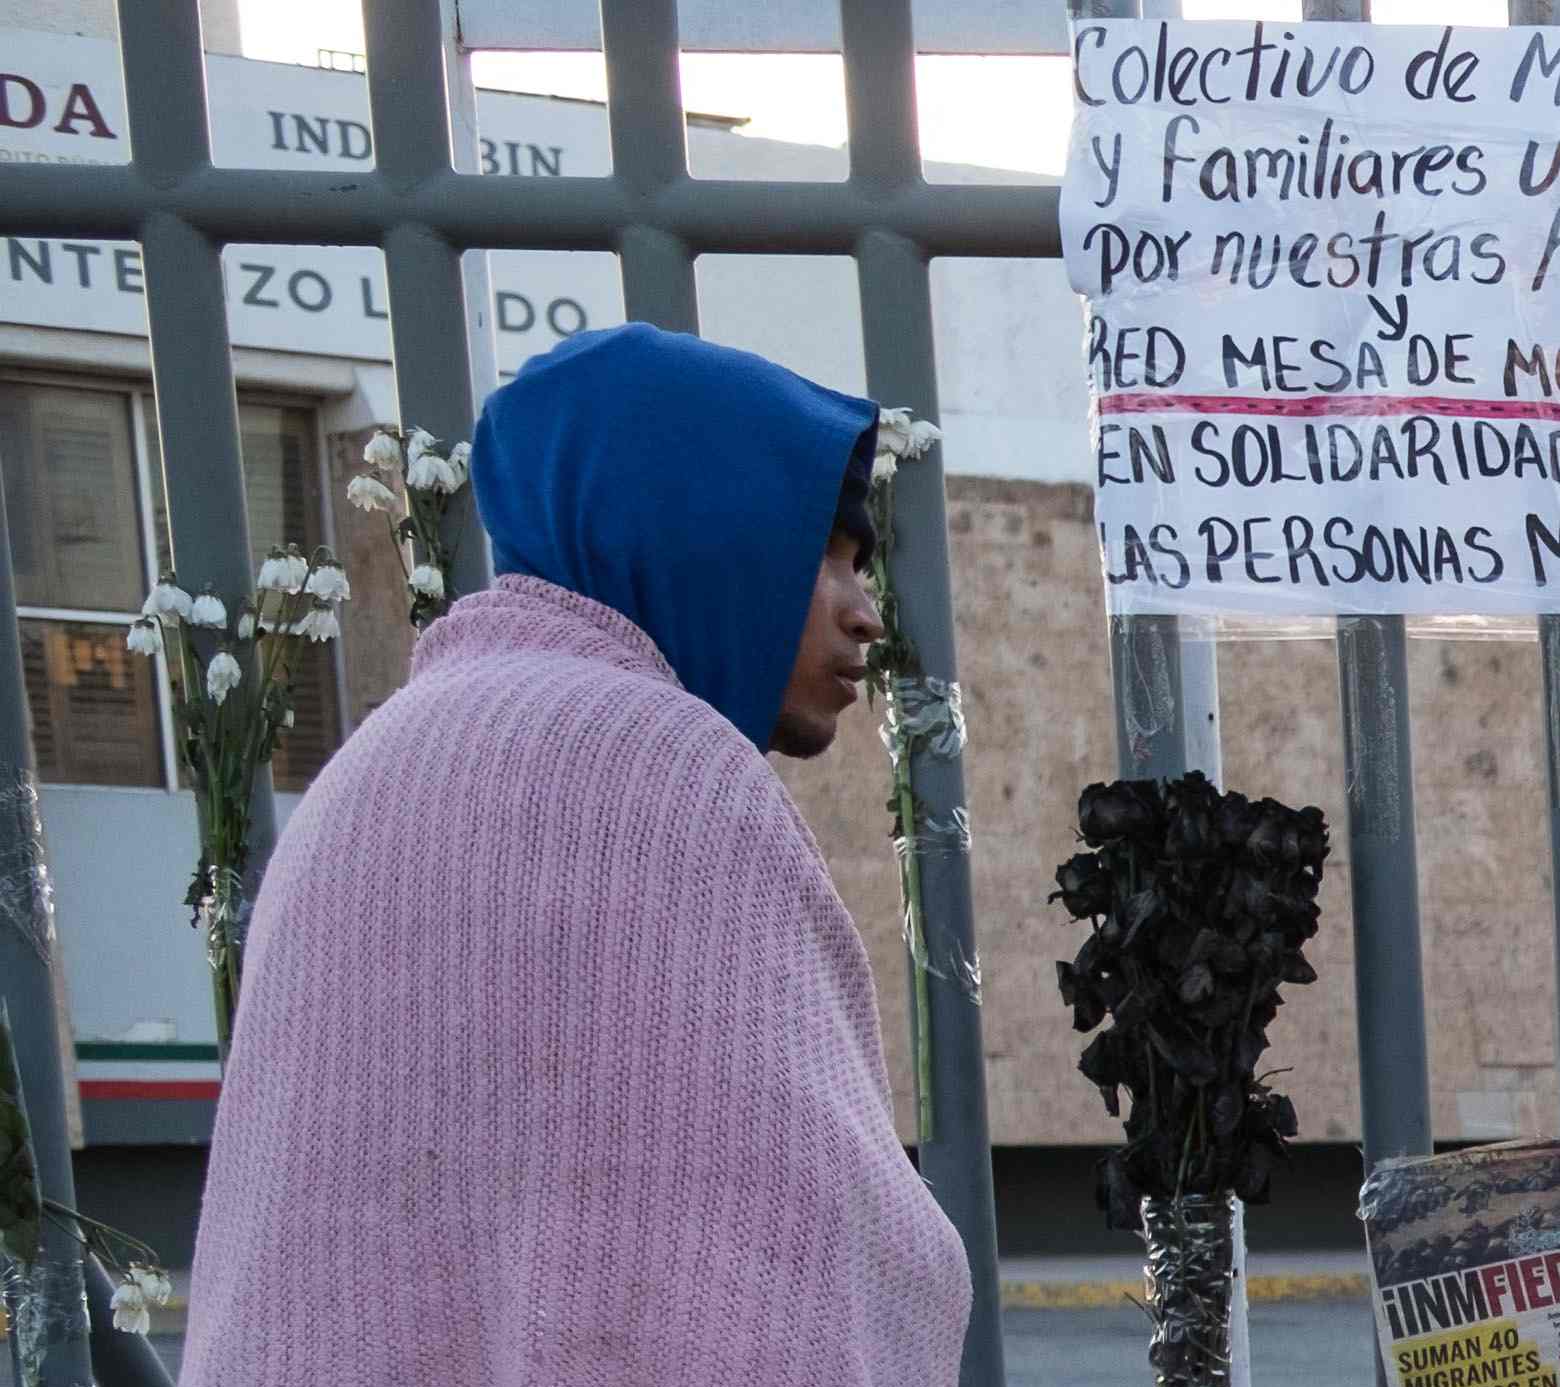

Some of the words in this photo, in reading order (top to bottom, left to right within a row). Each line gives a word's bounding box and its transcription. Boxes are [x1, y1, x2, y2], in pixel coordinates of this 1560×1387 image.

[1074, 22, 1374, 106] Colectivo
[1404, 27, 1479, 103] de
[268, 110, 563, 176] INDBIN
[1091, 133, 1122, 208] y
[10, 238, 332, 312] NTEZO
[361, 276, 588, 337] LDO
[1210, 210, 1506, 290] nuestras
[1088, 316, 1186, 391] RED
[1222, 334, 1389, 393] MESA
[1407, 332, 1475, 389] DE
[1098, 424, 1176, 488] EN
[1100, 522, 1191, 589] LAS
[1198, 515, 1504, 586] PERSONAS
[1398, 1335, 1481, 1374] SUMAN
[1488, 1328, 1519, 1353] 40
